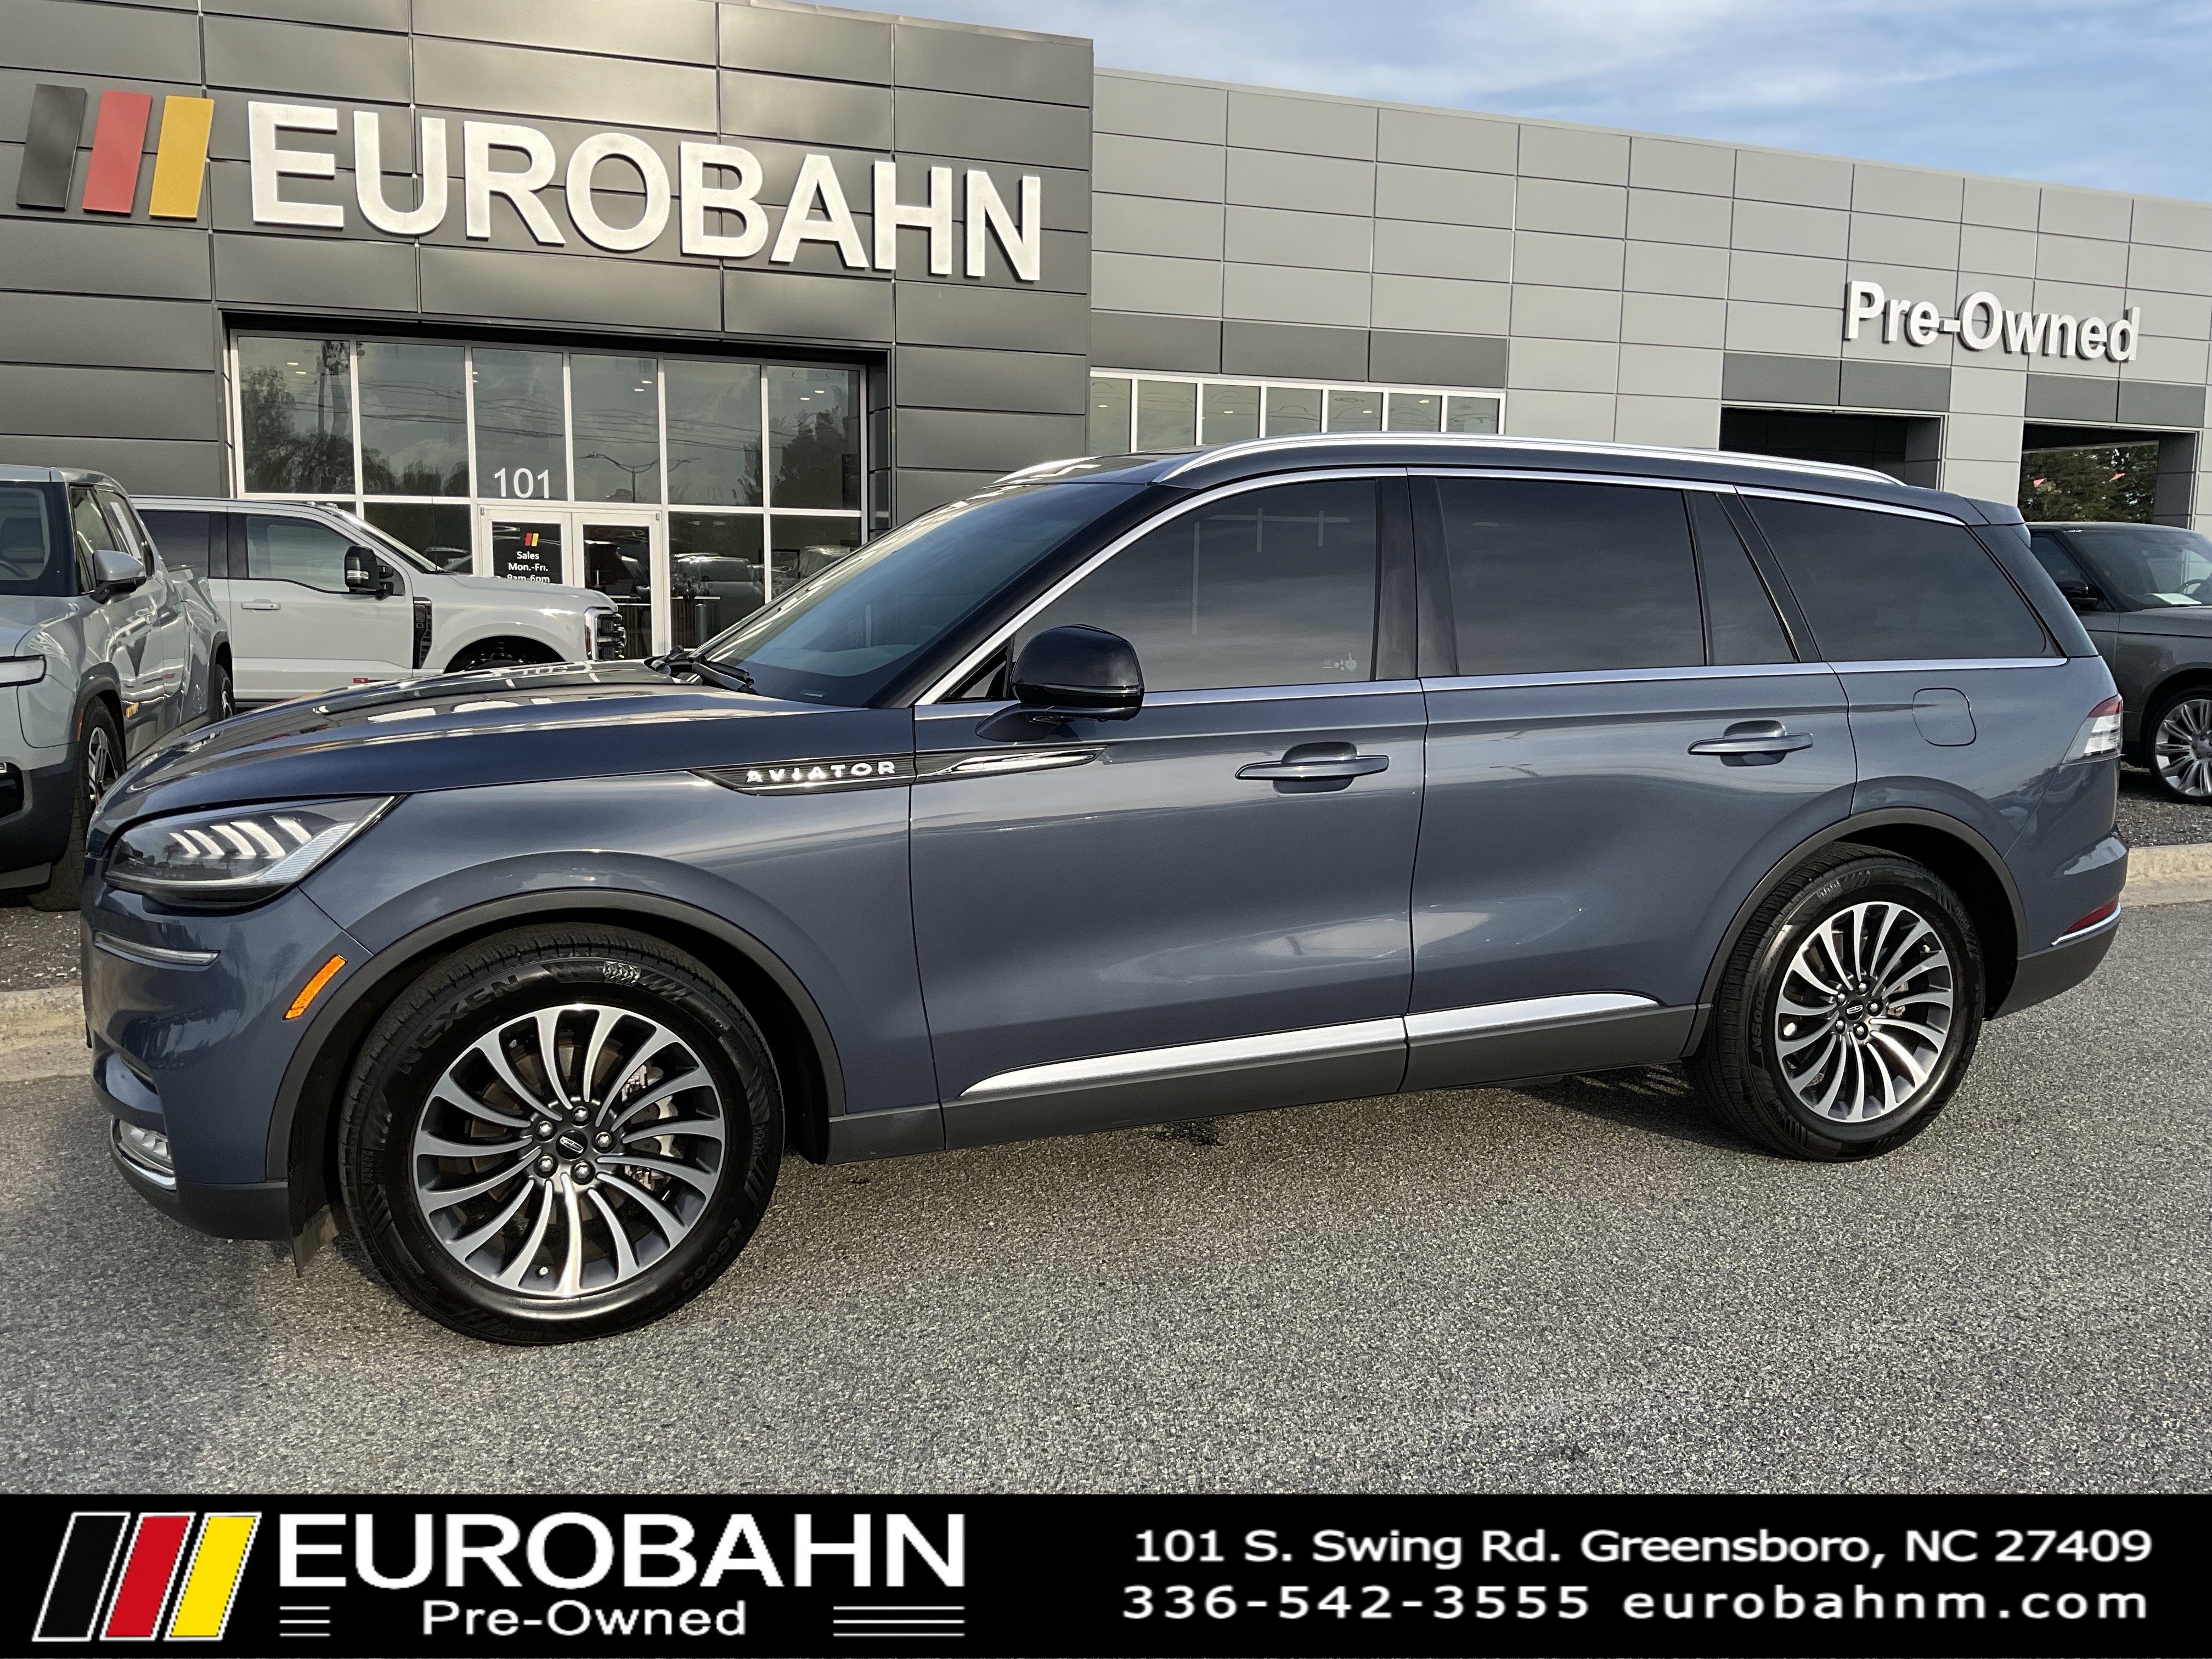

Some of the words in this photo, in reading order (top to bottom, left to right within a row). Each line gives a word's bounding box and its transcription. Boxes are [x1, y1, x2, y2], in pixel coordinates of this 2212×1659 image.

[248, 100, 1041, 281] EUROBAHN
[1844, 280, 2141, 361] Pre-Owned
[494, 467, 549, 499] 101
[508, 562, 549, 571] Mon.-Fri.
[516, 551, 540, 560] Sales
[746, 761, 896, 783] AVIATOR
[397, 975, 518, 1075] NEXEN
